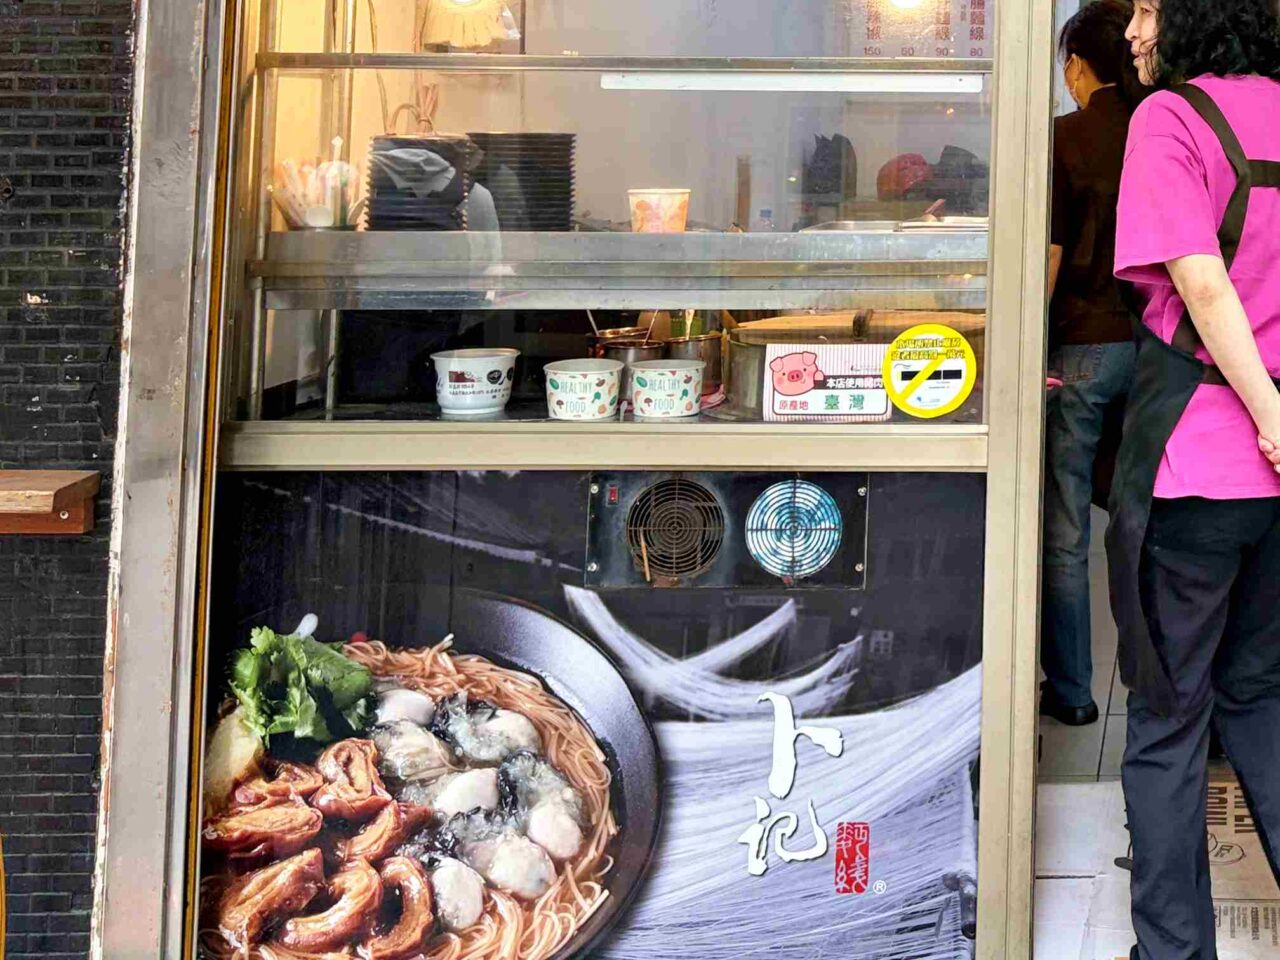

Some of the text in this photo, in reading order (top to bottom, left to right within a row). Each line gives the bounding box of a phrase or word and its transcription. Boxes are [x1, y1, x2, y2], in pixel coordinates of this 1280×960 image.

[560, 380, 593, 393] HEALTHY
[648, 378, 681, 391] HEALTHY
[565, 400, 586, 414] FOOD
[653, 397, 675, 411] FOOD
[779, 399, 809, 411] 原產地
[824, 393, 865, 411] 臺灣
[738, 691, 845, 876] 卜記
